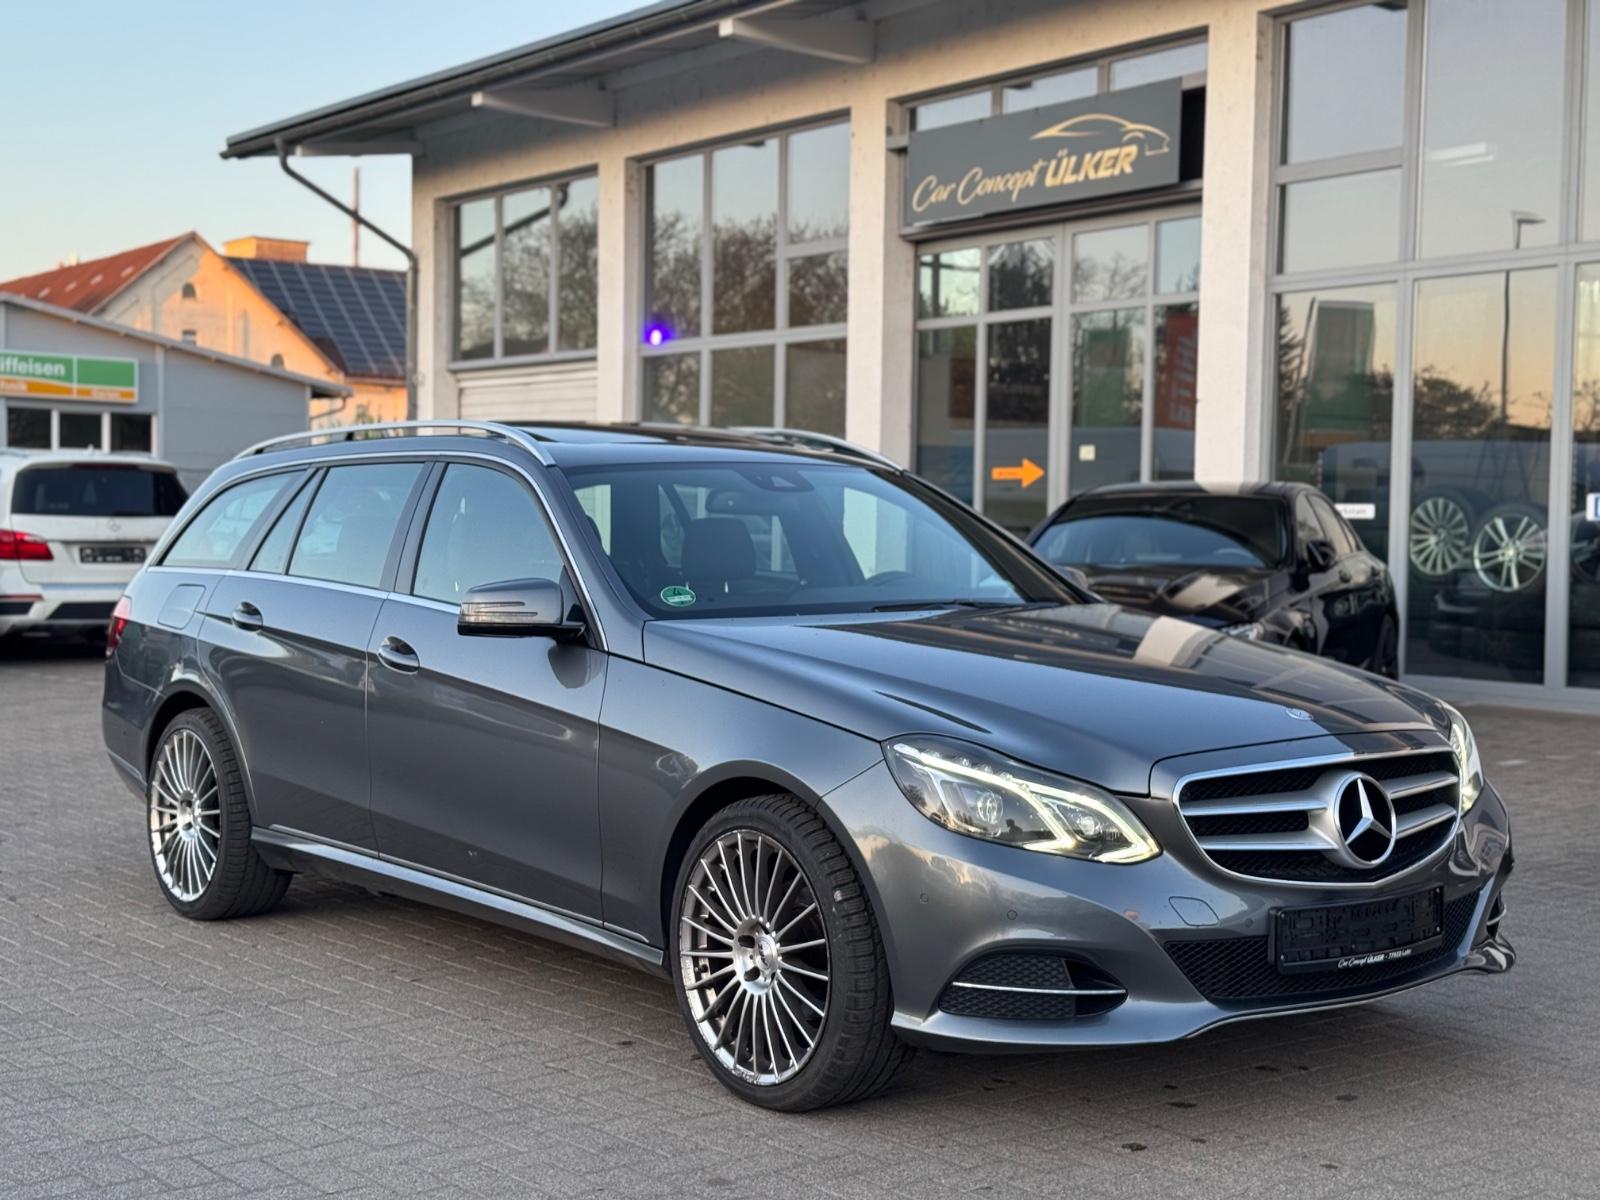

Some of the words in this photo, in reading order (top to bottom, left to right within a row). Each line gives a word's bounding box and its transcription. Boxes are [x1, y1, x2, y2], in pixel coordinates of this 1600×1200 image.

[912, 175, 956, 212] Car
[956, 159, 1048, 203] Concept
[1045, 144, 1139, 188] ÜLKER
